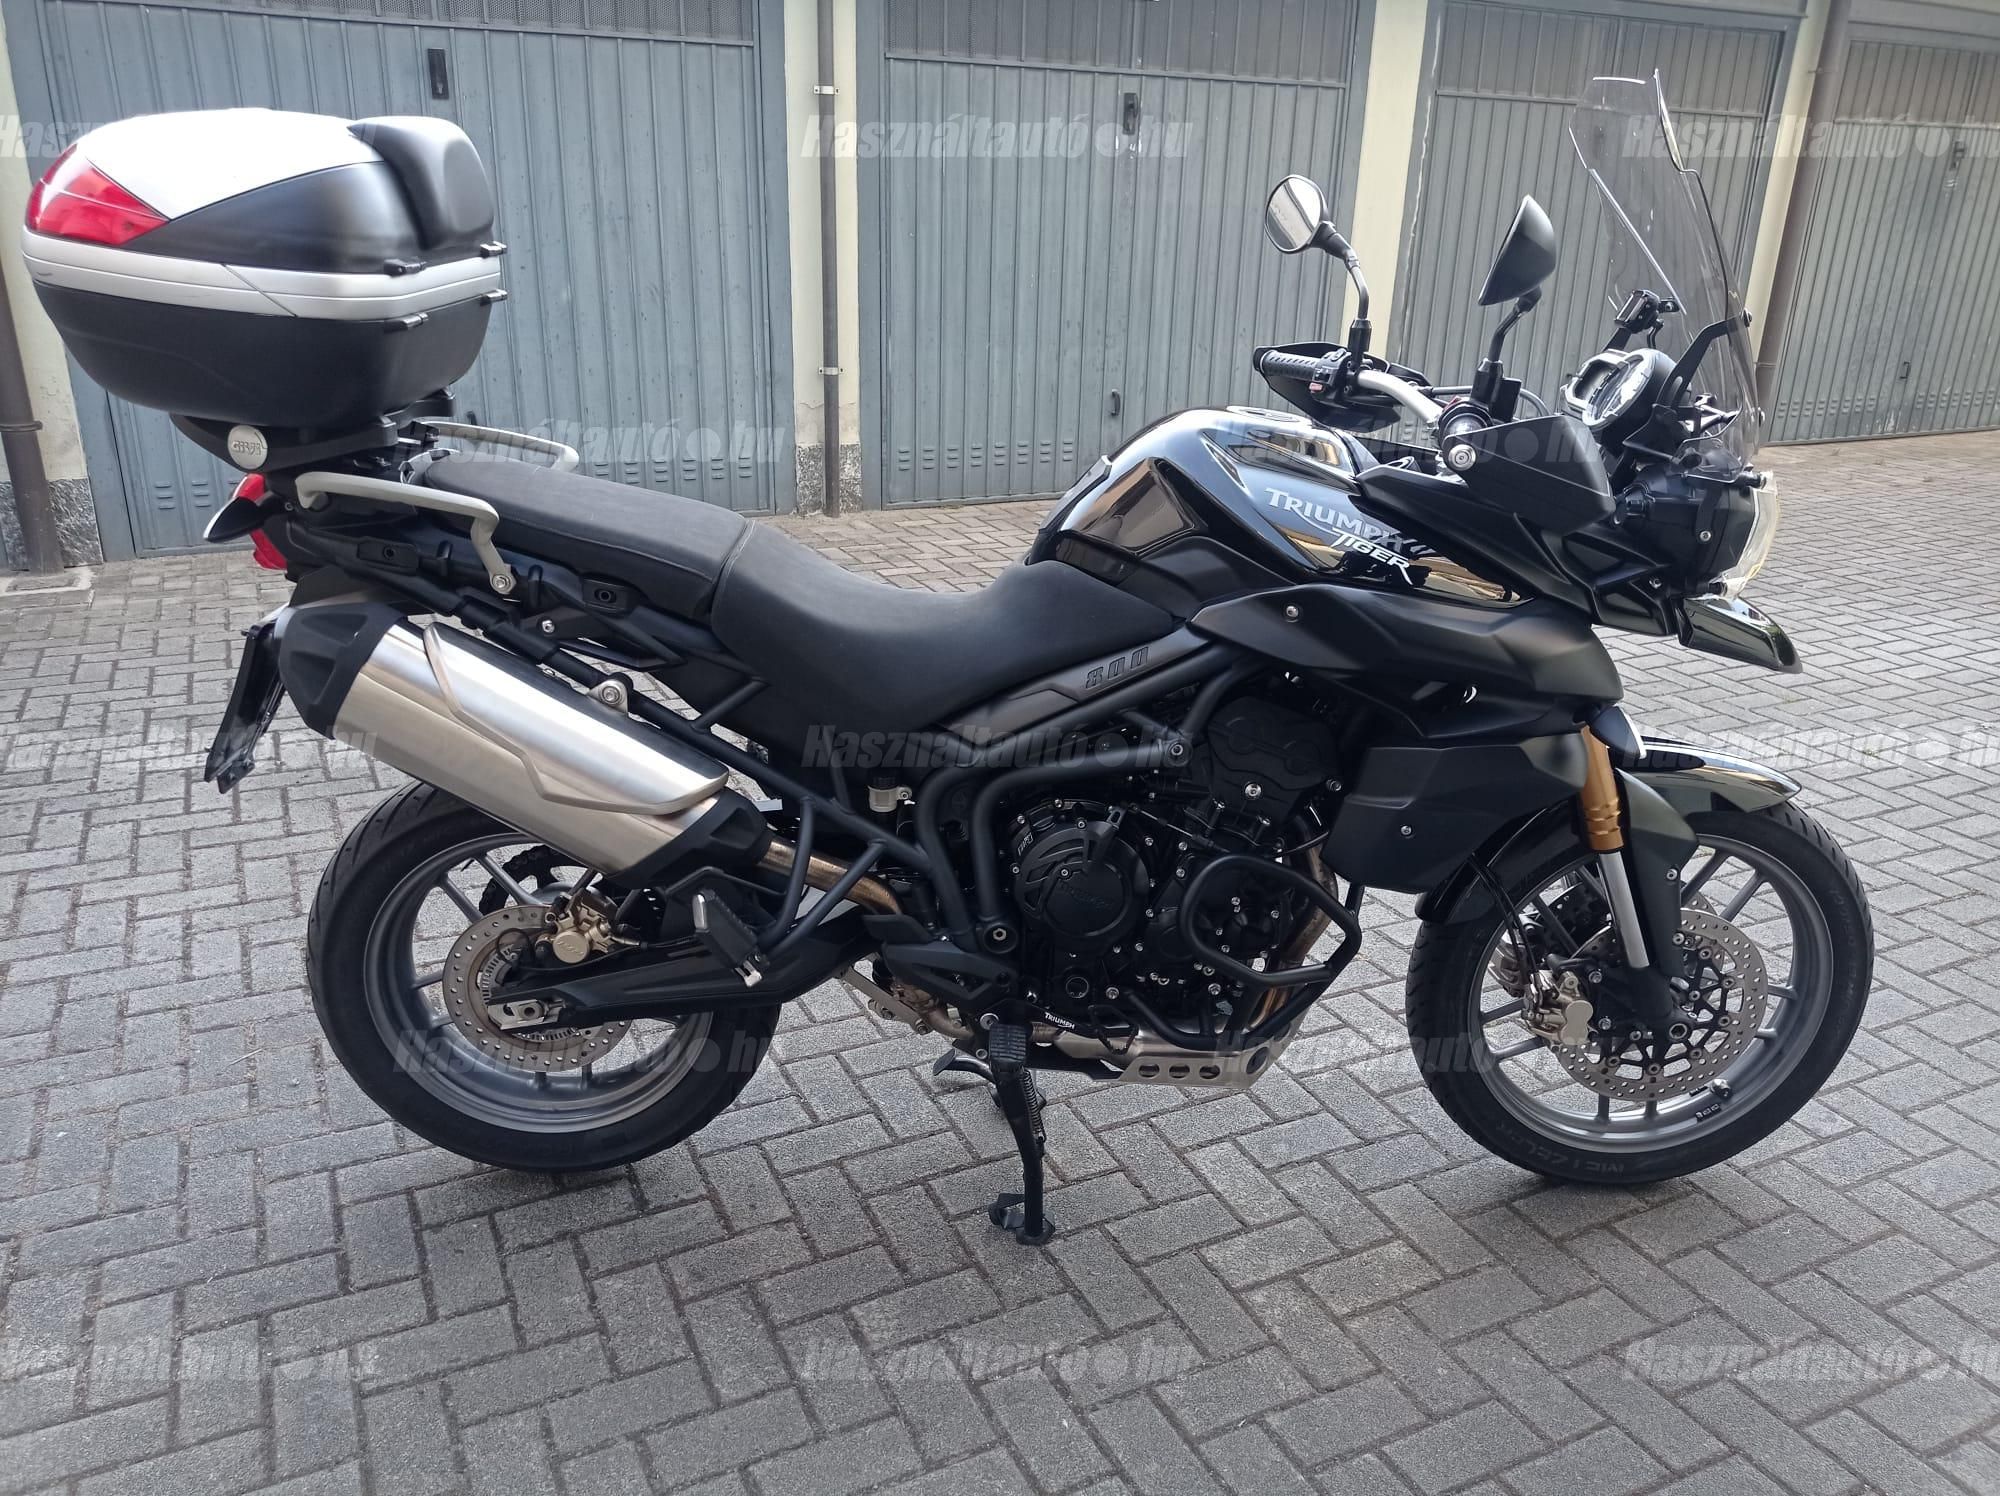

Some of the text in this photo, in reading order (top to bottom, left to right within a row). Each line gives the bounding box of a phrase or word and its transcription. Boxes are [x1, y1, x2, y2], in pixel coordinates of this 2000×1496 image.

[1264, 487, 1404, 554] TRIUMPH
[1331, 527, 1414, 586] TIGER
[1084, 645, 1149, 691] 800
[1044, 1011, 1076, 1030] TRIUMPH
